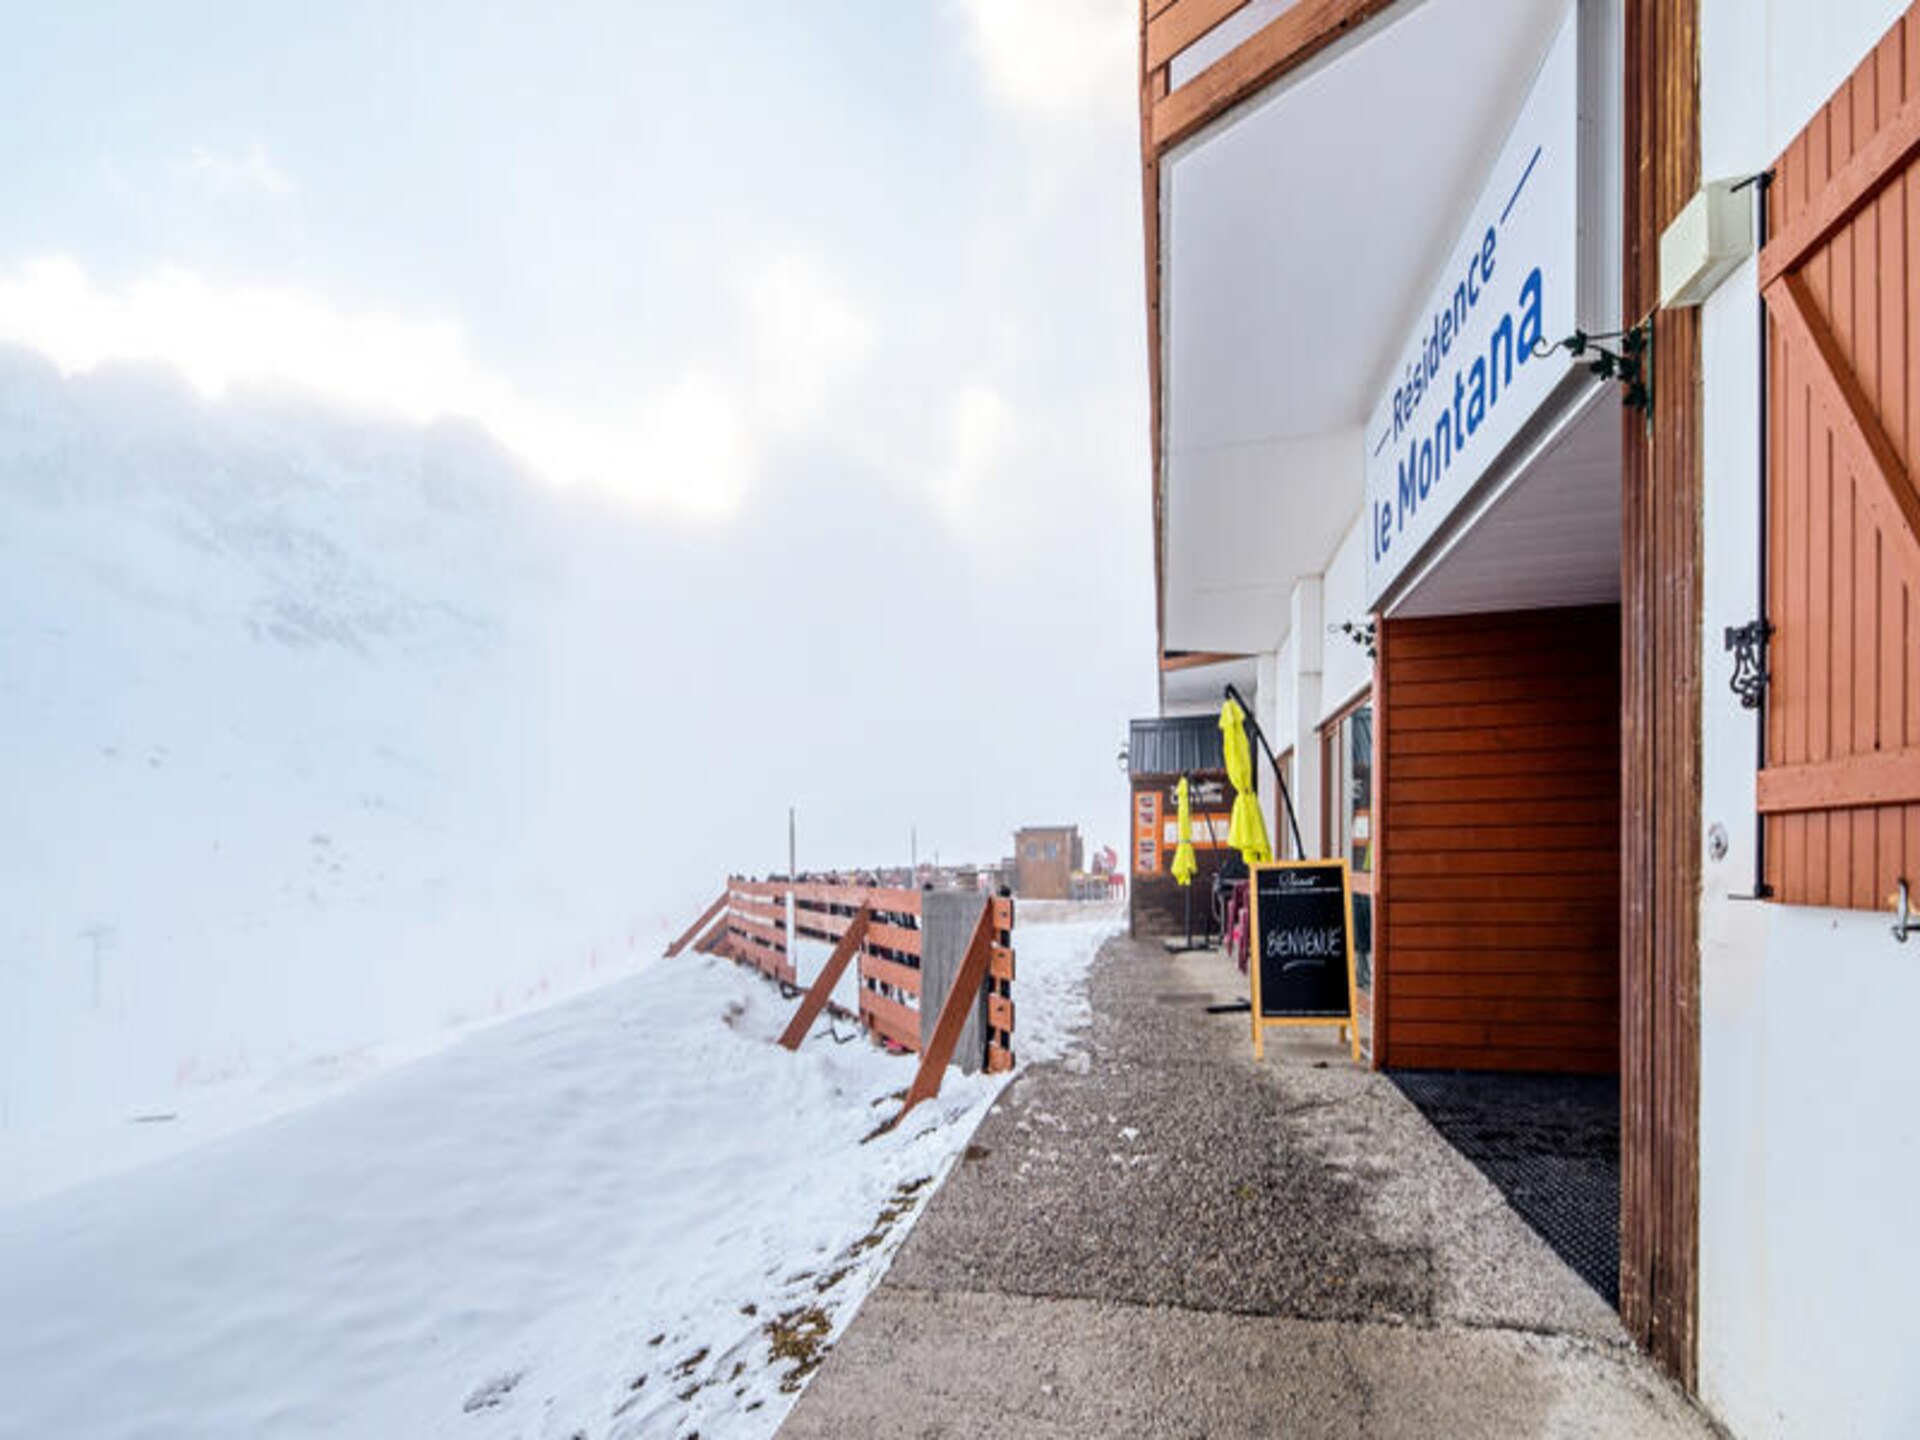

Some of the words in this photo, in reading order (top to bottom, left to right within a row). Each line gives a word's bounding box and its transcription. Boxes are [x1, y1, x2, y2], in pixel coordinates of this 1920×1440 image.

[1374, 501, 1392, 563] le
[1398, 266, 1543, 533] Montana
[1393, 224, 1497, 443] Résidence
